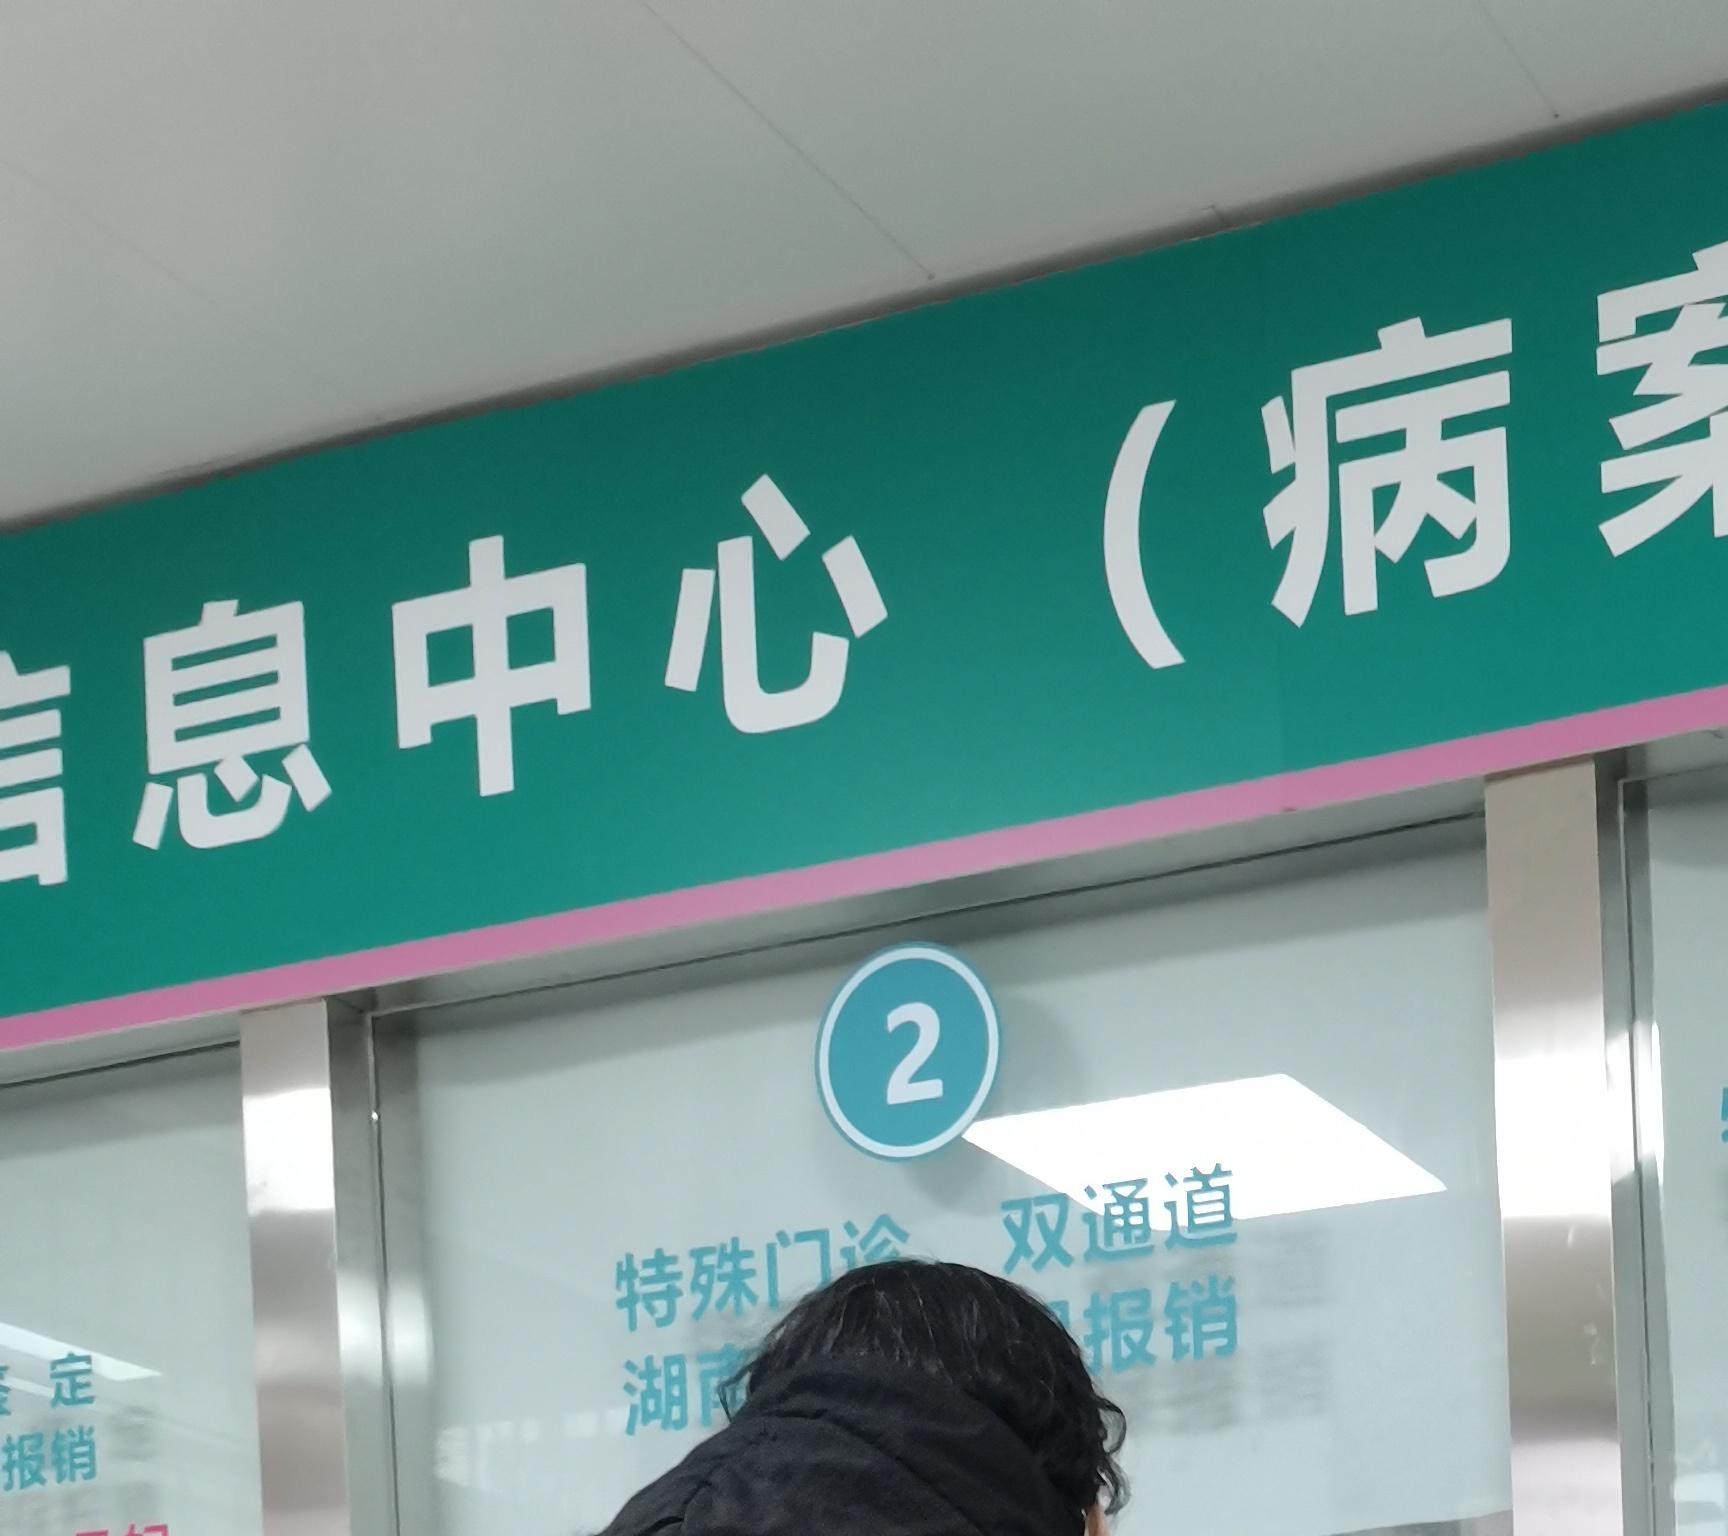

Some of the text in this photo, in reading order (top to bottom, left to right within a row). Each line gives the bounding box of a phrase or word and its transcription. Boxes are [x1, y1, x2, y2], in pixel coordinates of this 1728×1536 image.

[886, 1001, 943, 1105] 2
[615, 1162, 1238, 1332] 特殊门诊 双通道
[1046, 1273, 1238, 1376] 报销
[2, 1424, 98, 1492] 报销
